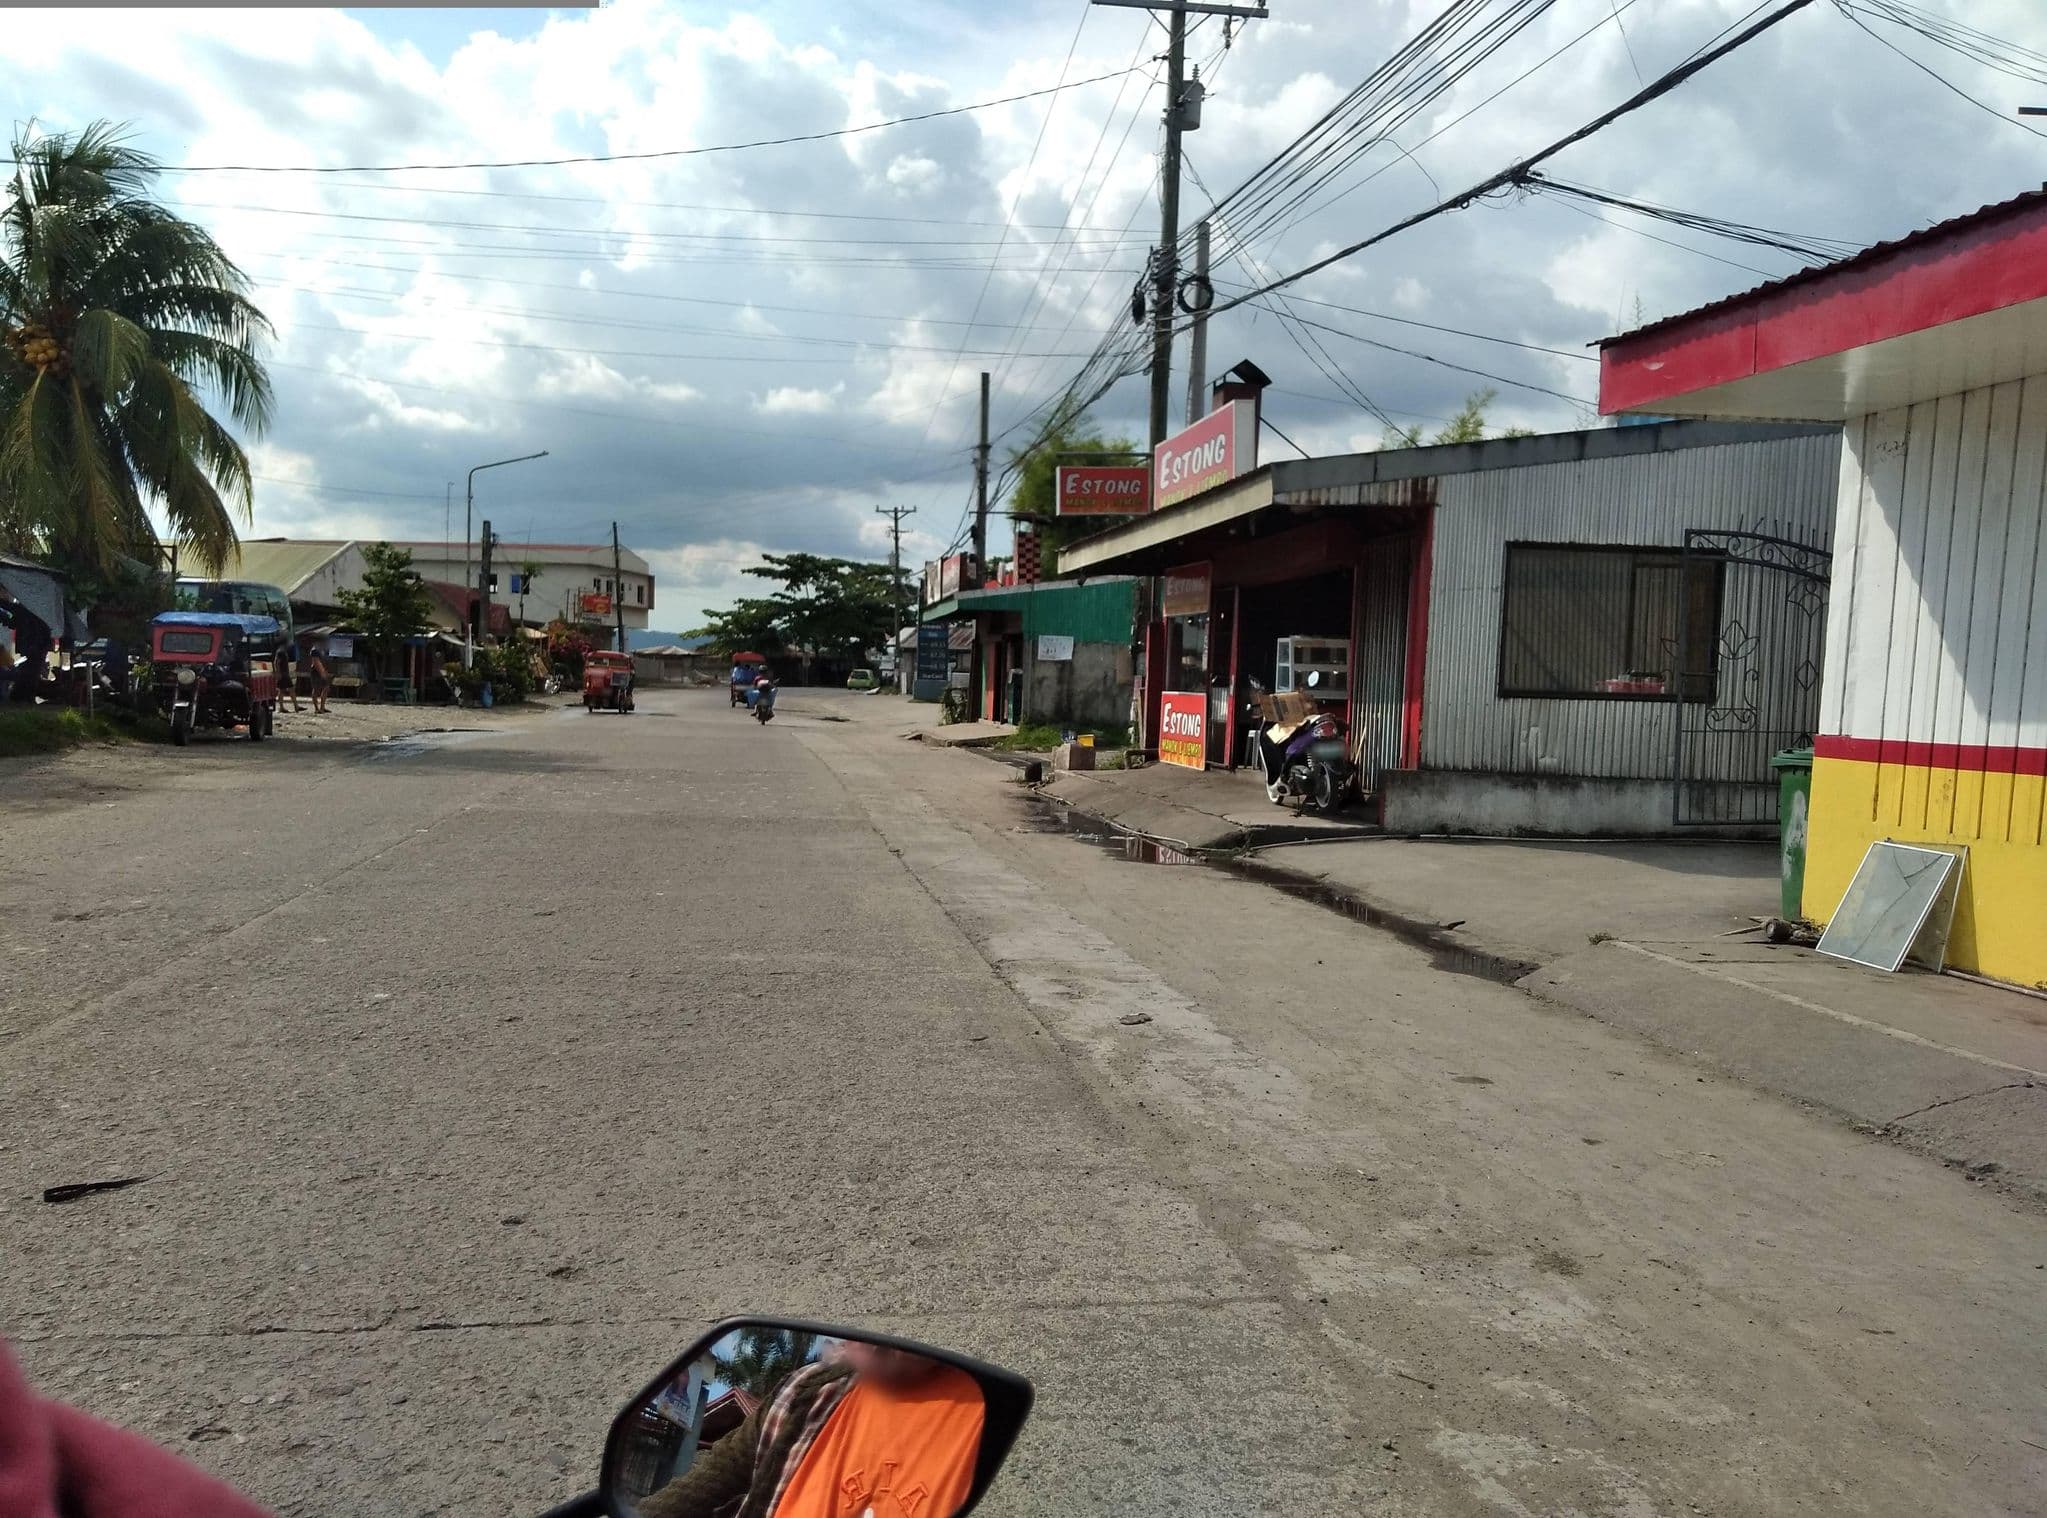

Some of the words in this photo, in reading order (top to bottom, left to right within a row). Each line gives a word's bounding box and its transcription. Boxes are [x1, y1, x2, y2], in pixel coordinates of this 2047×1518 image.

[1160, 433, 1226, 490] ESTONG
[1066, 473, 1141, 494] ESTONG
[1163, 702, 1201, 738] ESTONG
